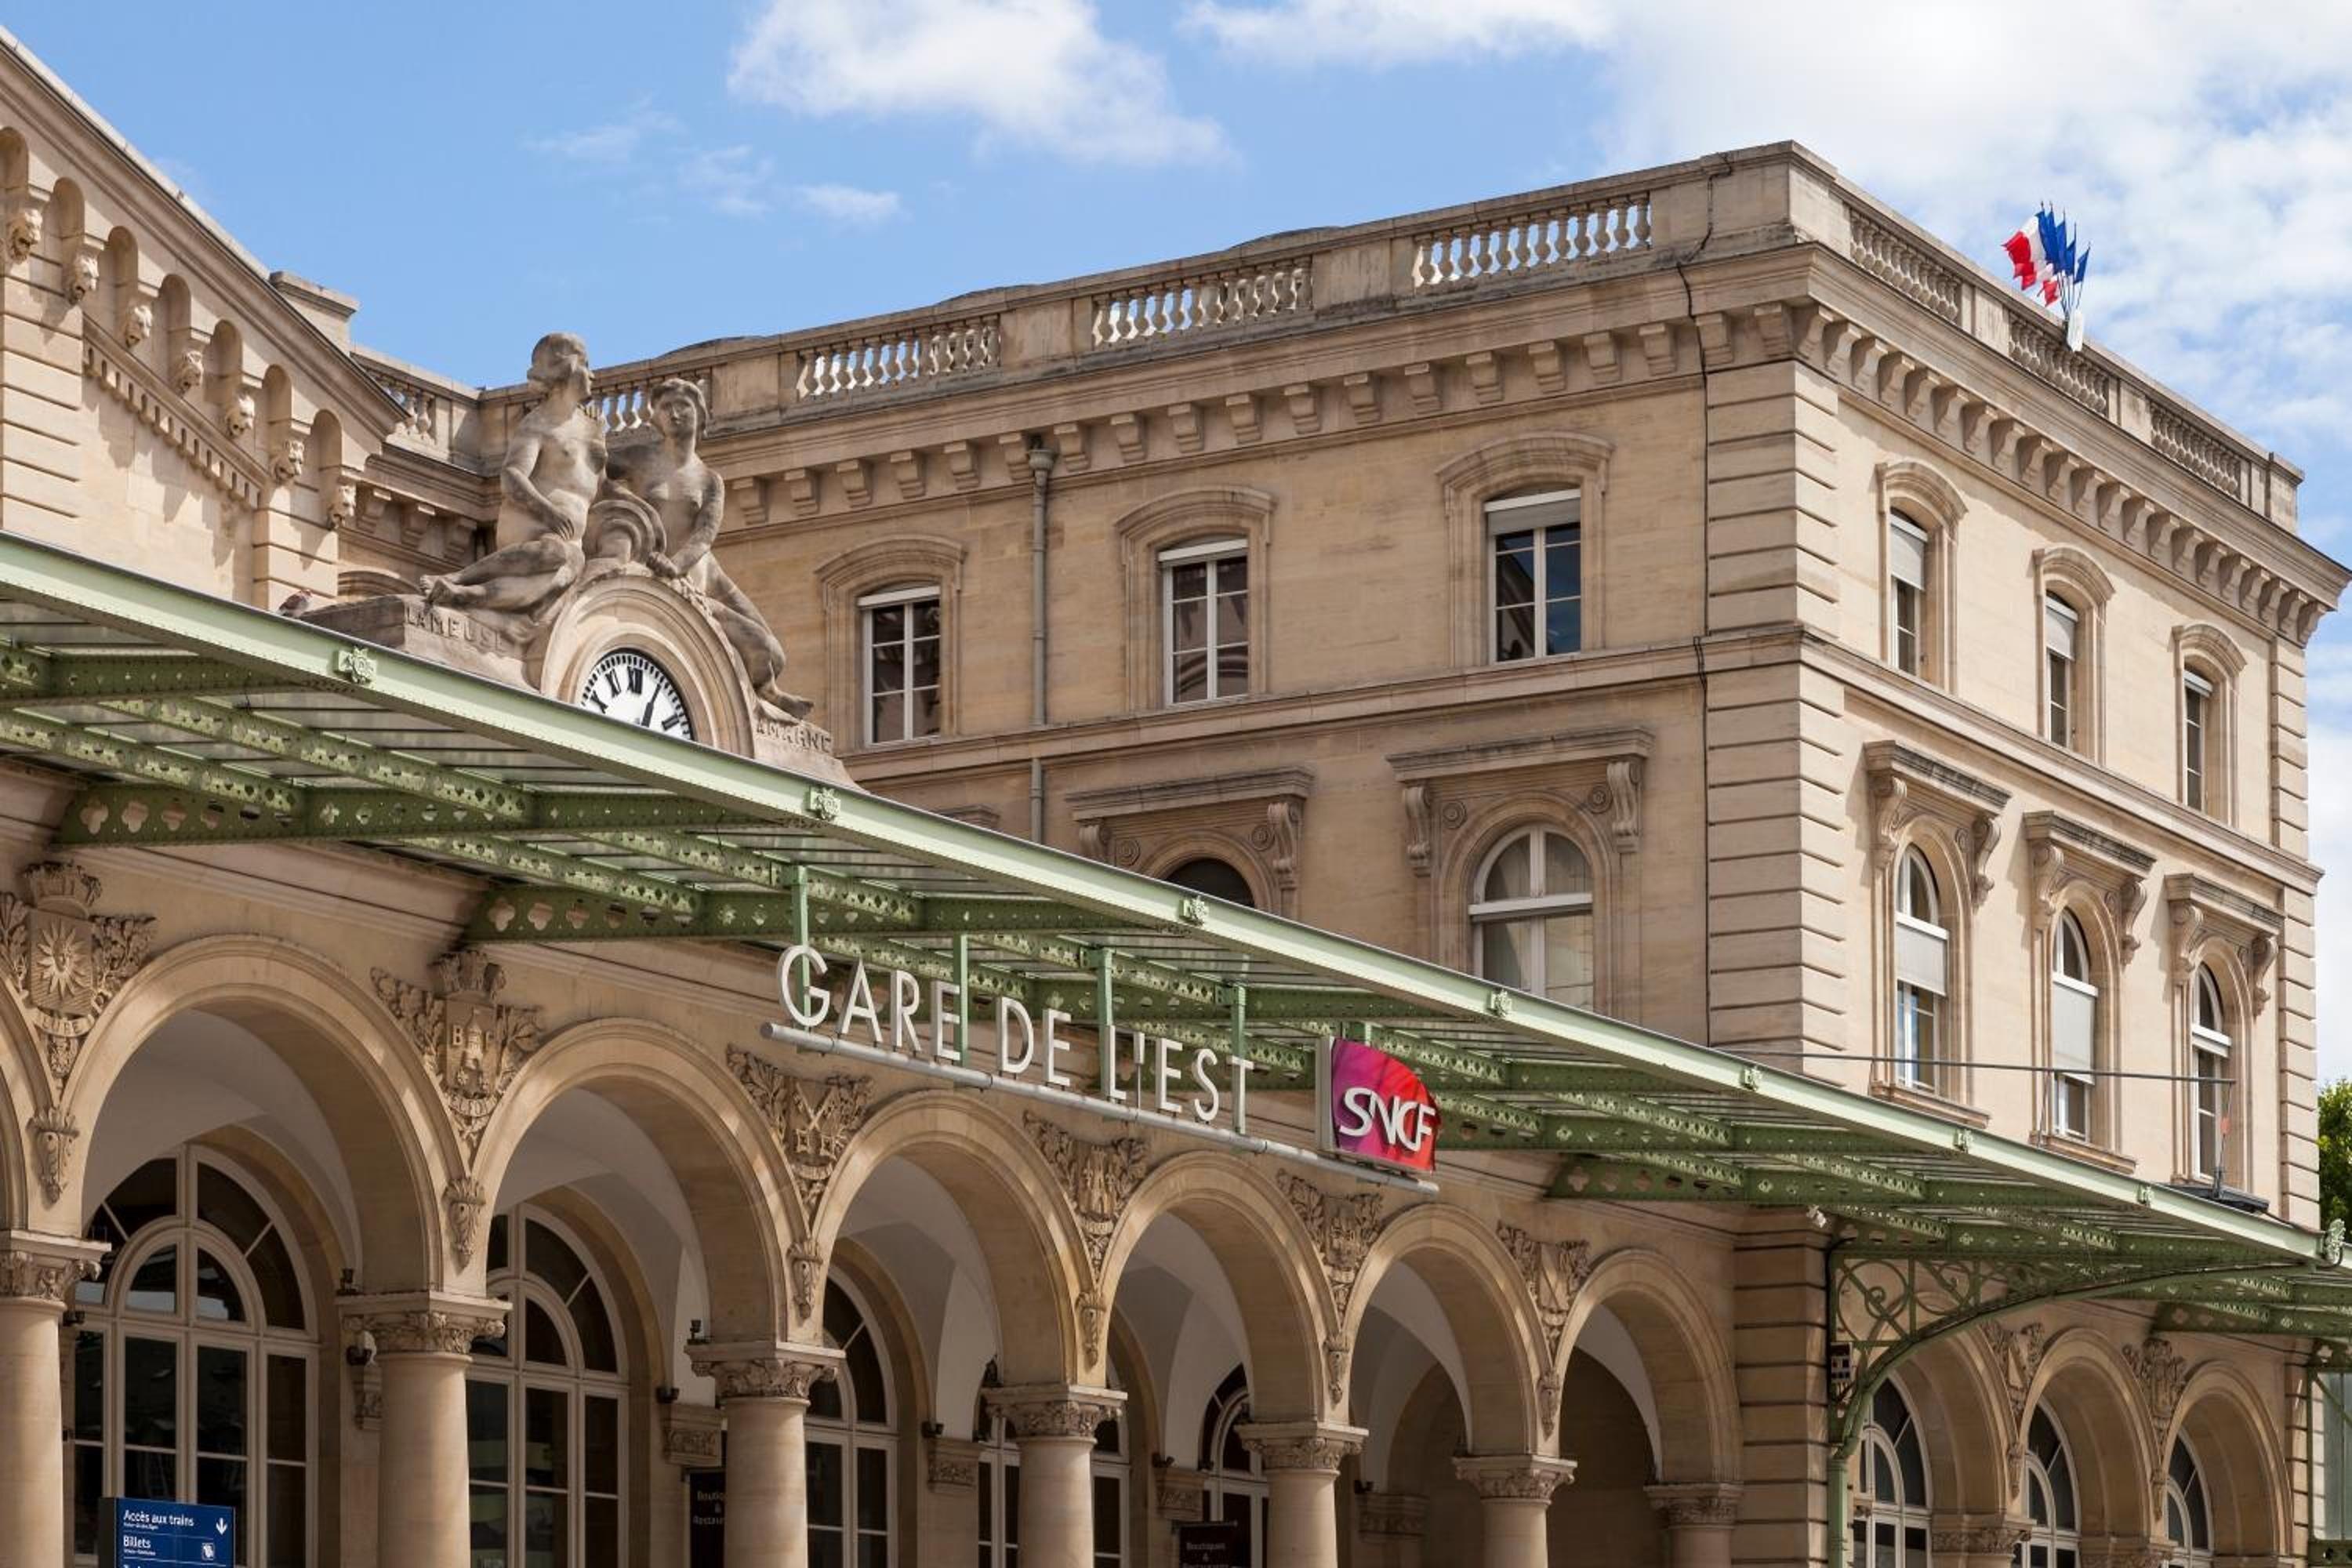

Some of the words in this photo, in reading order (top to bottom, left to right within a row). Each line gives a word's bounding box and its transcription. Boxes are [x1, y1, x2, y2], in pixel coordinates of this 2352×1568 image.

[626, 666, 644, 695] XII
[779, 944, 961, 1062] GARE
[995, 996, 1072, 1087] DE
[1105, 1024, 1254, 1135] L'EST
[1338, 1087, 1436, 1152] SNCF
[123, 1508, 150, 1523] Accès
[151, 1514, 168, 1525] aux
[169, 1514, 195, 1527] trains
[123, 1535, 151, 1548] Billets
